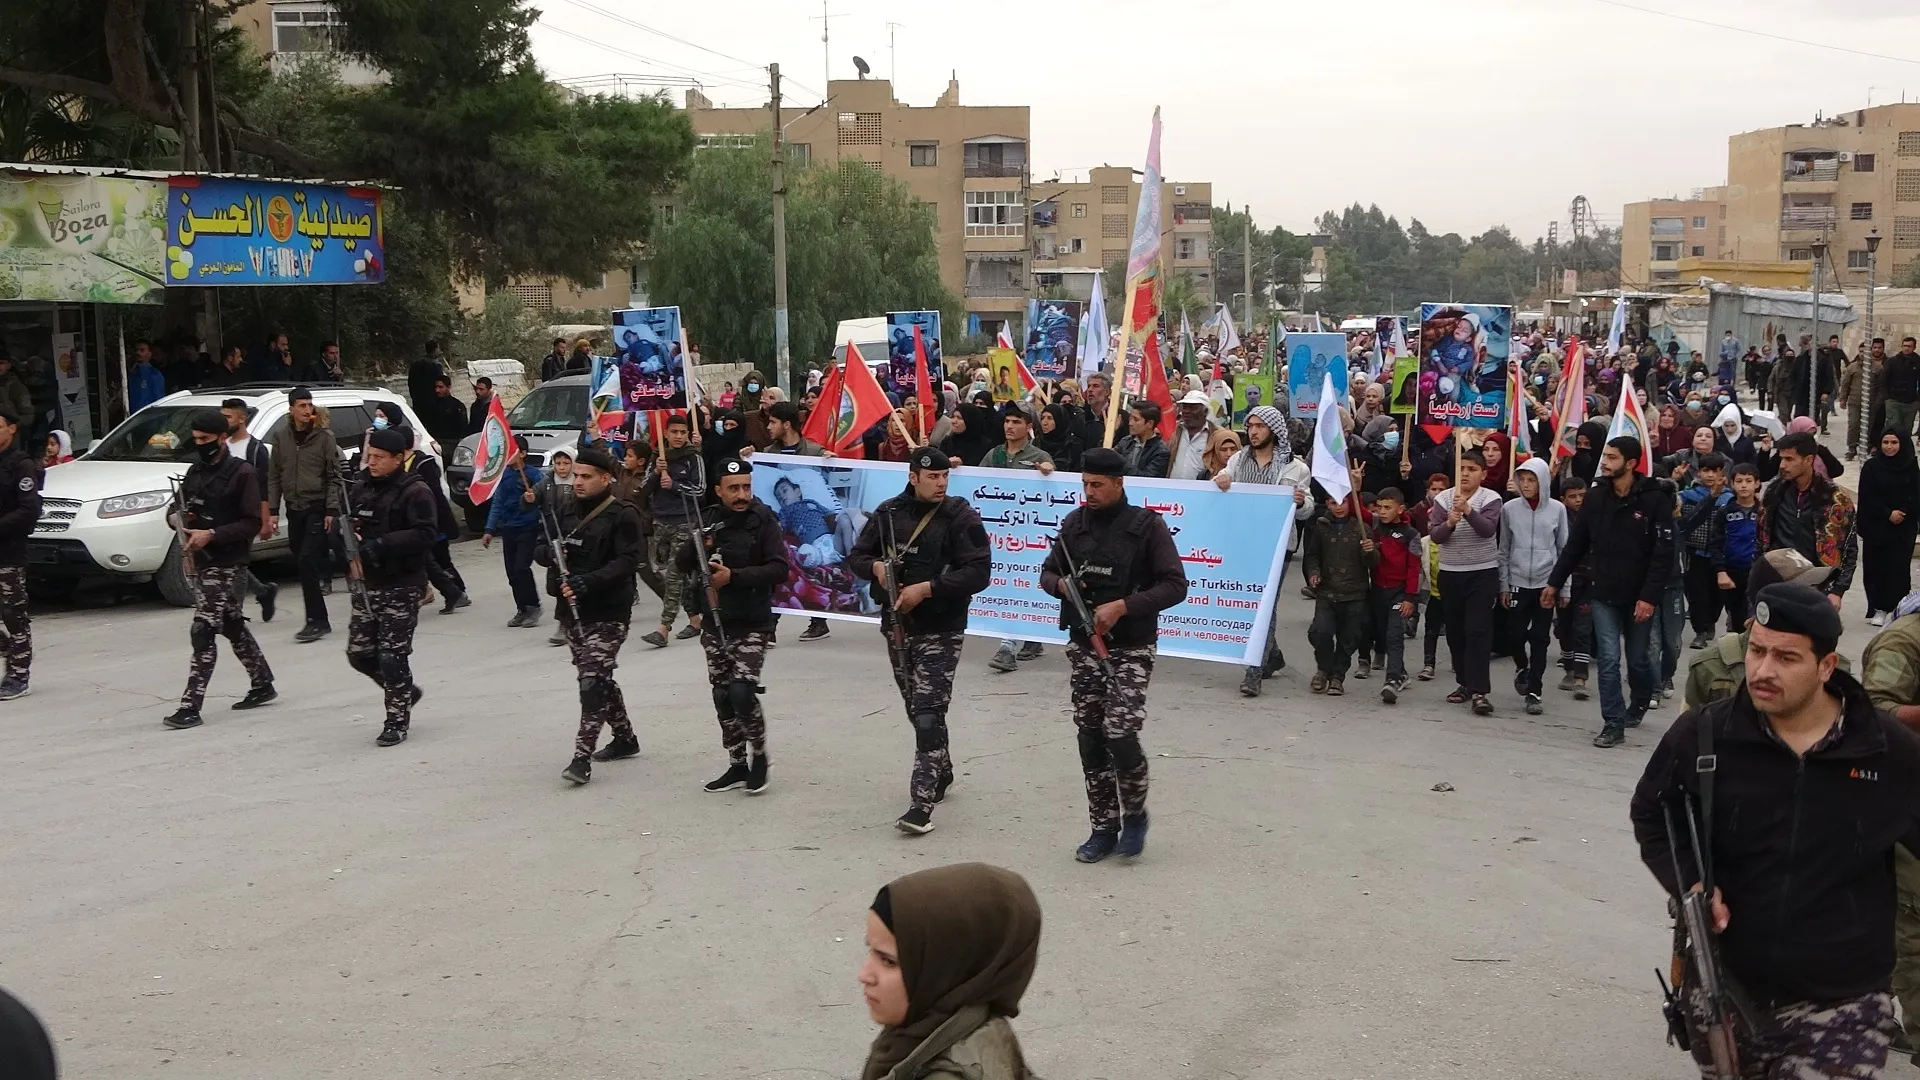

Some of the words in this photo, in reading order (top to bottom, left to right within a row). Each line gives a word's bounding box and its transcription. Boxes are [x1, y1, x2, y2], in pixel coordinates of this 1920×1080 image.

[62, 199, 101, 217] Sailora
[178, 191, 264, 247] الحسن
[297, 190, 373, 252] صيدلية
[49, 213, 109, 244] Boza
[1006, 563, 1031, 574] your
[1200, 578, 1244, 592] Turkish
[976, 595, 1029, 609] прекратите
[1031, 601, 1061, 611] молча
[1013, 577, 1031, 589] the
[1187, 595, 1209, 605] and
[1217, 596, 1261, 610] human
[1001, 611, 1019, 621] вам
[1021, 612, 1061, 626] ответств
[1156, 626, 1181, 637] рией
[1184, 630, 1191, 638] и
[1859, 769, 1879, 781] 5.11
